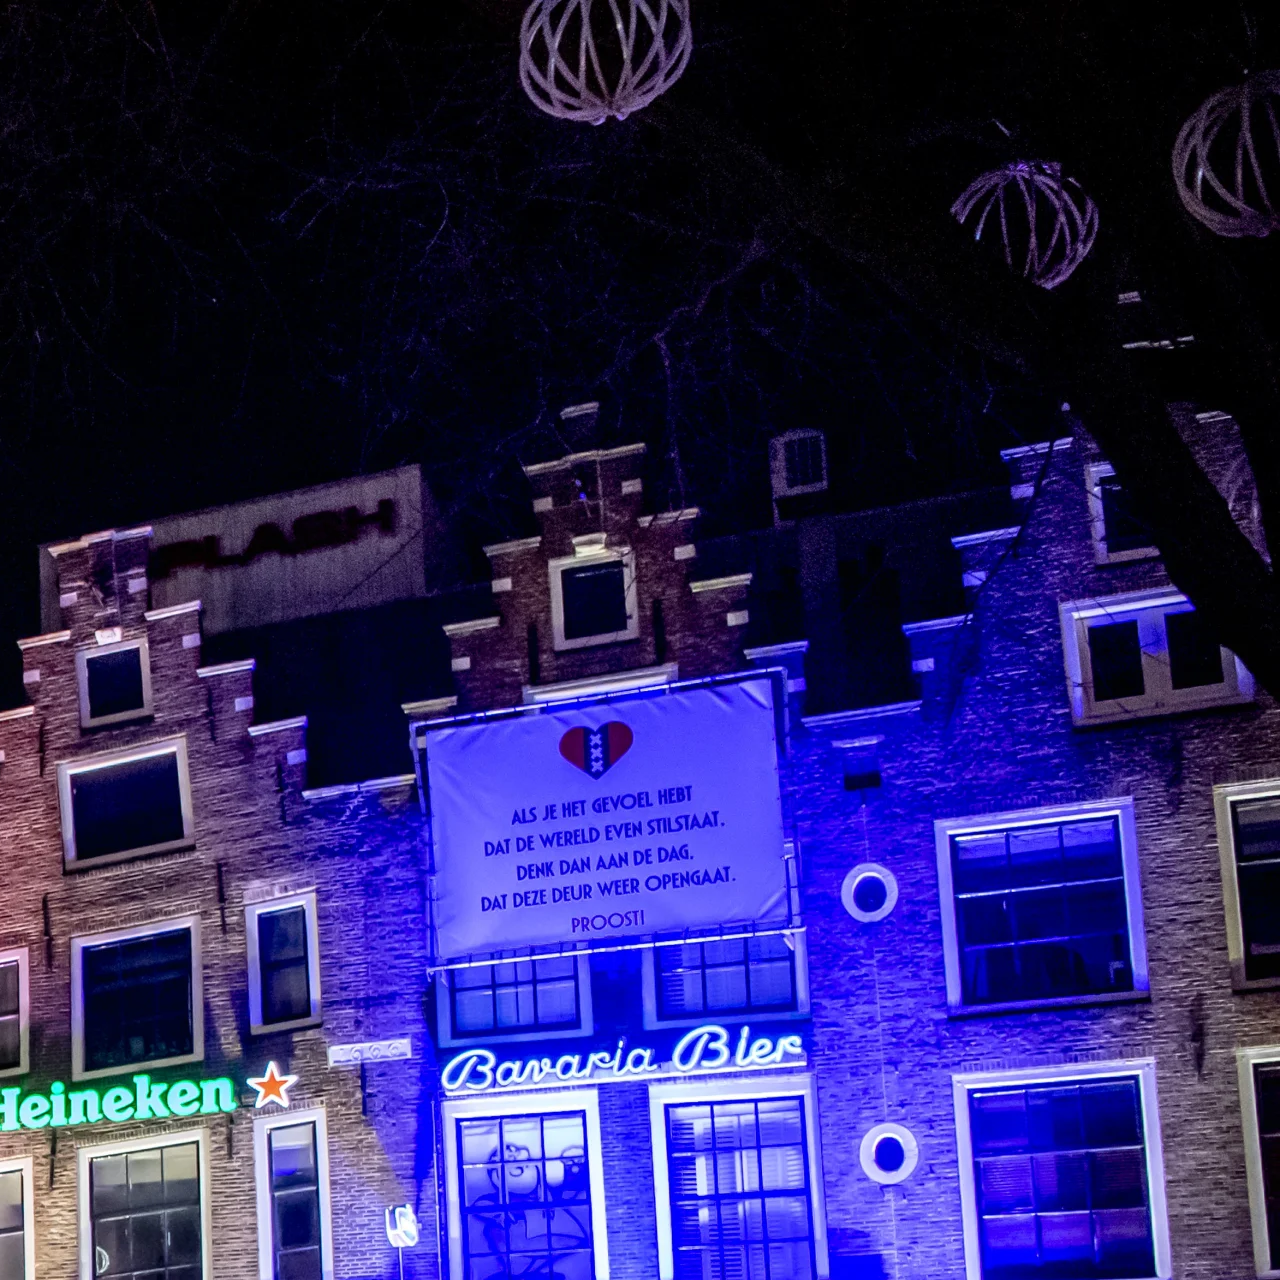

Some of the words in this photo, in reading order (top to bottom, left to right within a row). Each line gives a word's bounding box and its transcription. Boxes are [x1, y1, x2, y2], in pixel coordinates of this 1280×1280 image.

[511, 806, 538, 826] ALS
[542, 803, 558, 821] JE
[562, 799, 587, 819] HET
[592, 791, 654, 814] GEVOEL
[658, 785, 693, 805] HEBT
[484, 838, 511, 857] DAT
[516, 835, 535, 852] DE
[539, 827, 601, 849] WERELD
[605, 820, 643, 842] EVEN
[647, 810, 726, 836] STILSTAAT.
[516, 861, 555, 881] DENK
[559, 856, 591, 876] DAN
[596, 851, 629, 871] AAN
[633, 848, 653, 866] DE
[658, 844, 694, 864] DAG.
[481, 893, 508, 911] DAT
[513, 889, 547, 908] DEZE
[552, 884, 592, 903] DEUR
[597, 878, 640, 897] WEER
[644, 866, 737, 892] OPENGAAT.
[440, 1036, 655, 1091] Bavaria
[672, 1024, 803, 1072] Bier
